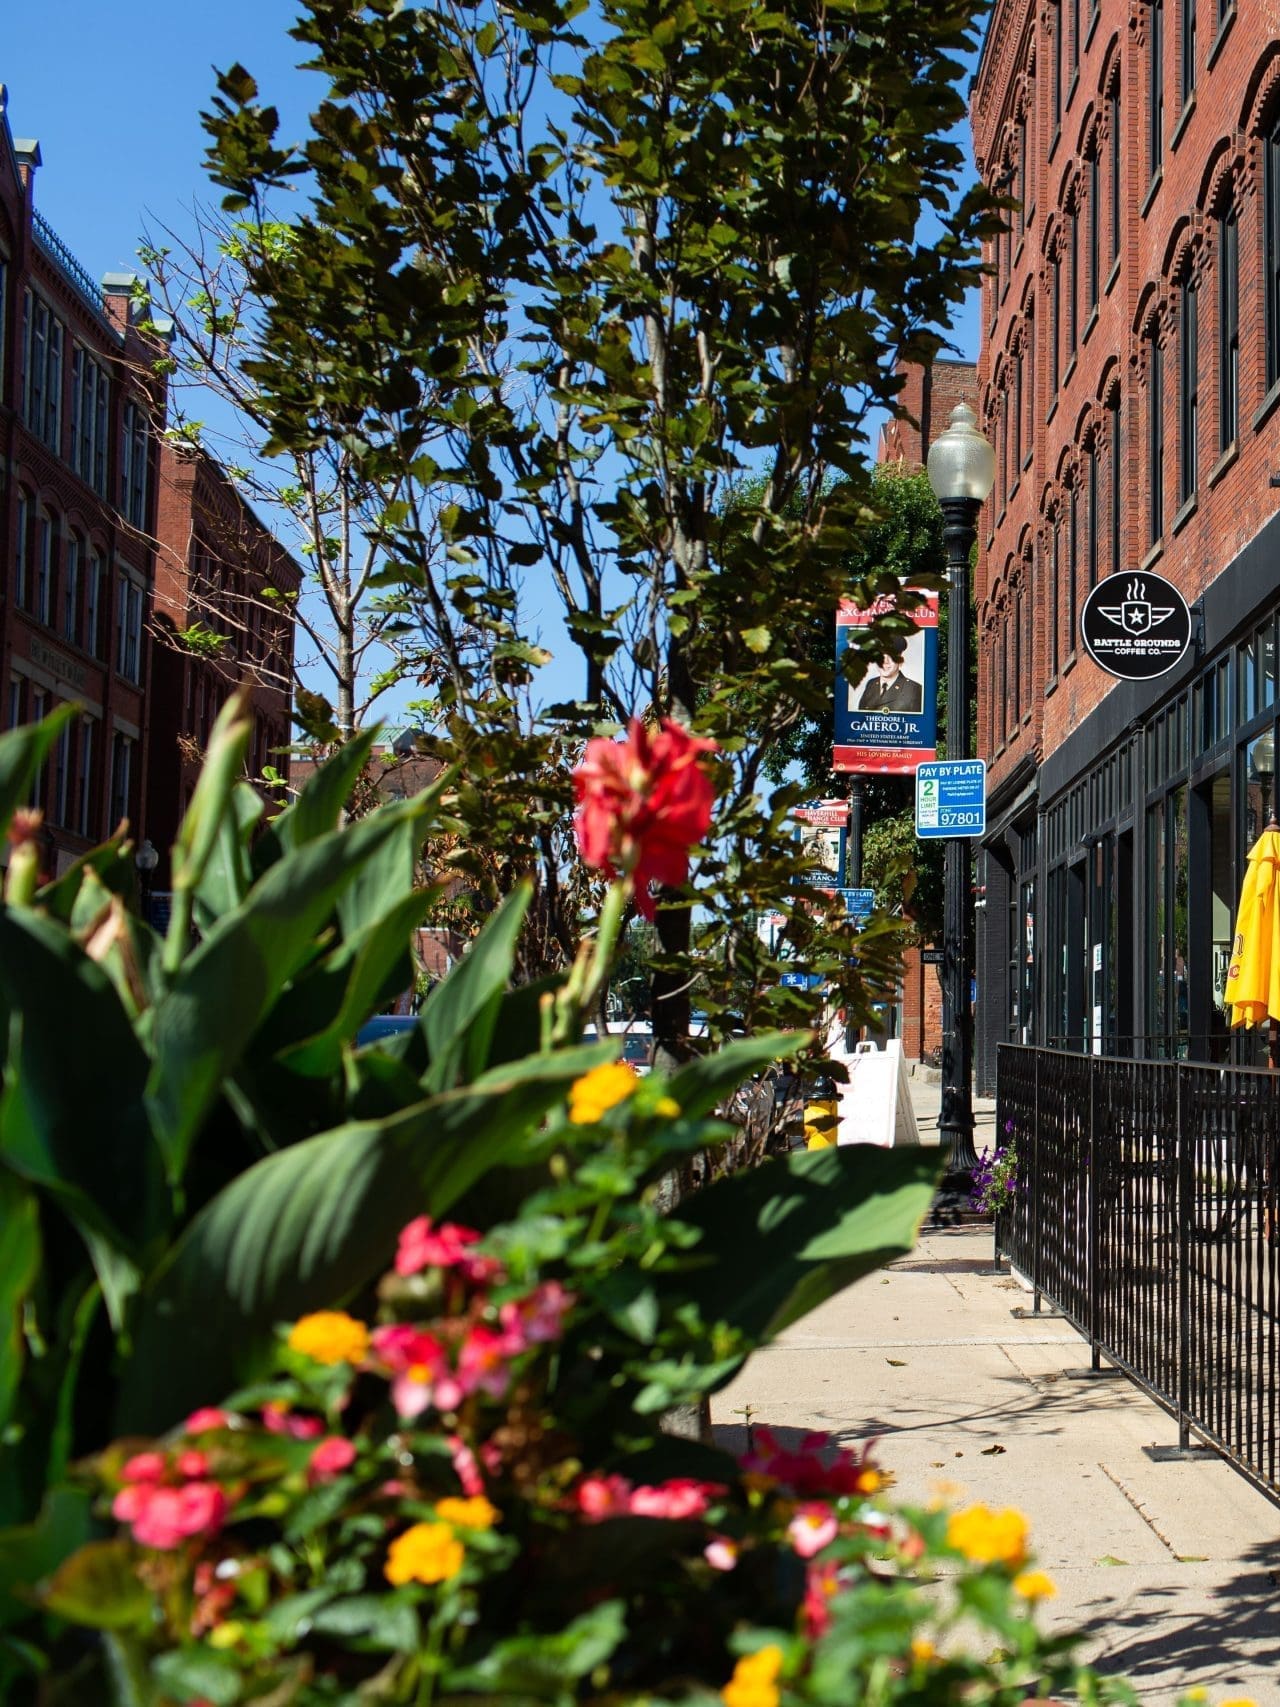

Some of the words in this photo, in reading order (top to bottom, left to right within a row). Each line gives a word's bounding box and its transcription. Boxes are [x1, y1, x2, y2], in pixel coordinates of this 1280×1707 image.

[905, 608, 936, 618] CLUB
[1093, 638, 1132, 647] BATTLE
[1133, 639, 1181, 648] GROUNDS
[1114, 647, 1146, 655] COFFEE
[1147, 648, 1161, 656] CO.
[865, 715, 901, 723] THEODORE
[919, 767, 937, 778] PAY
[939, 766, 952, 777] BY
[953, 765, 983, 776] PLATE
[923, 780, 934, 796] 2
[941, 812, 980, 826] 97801
